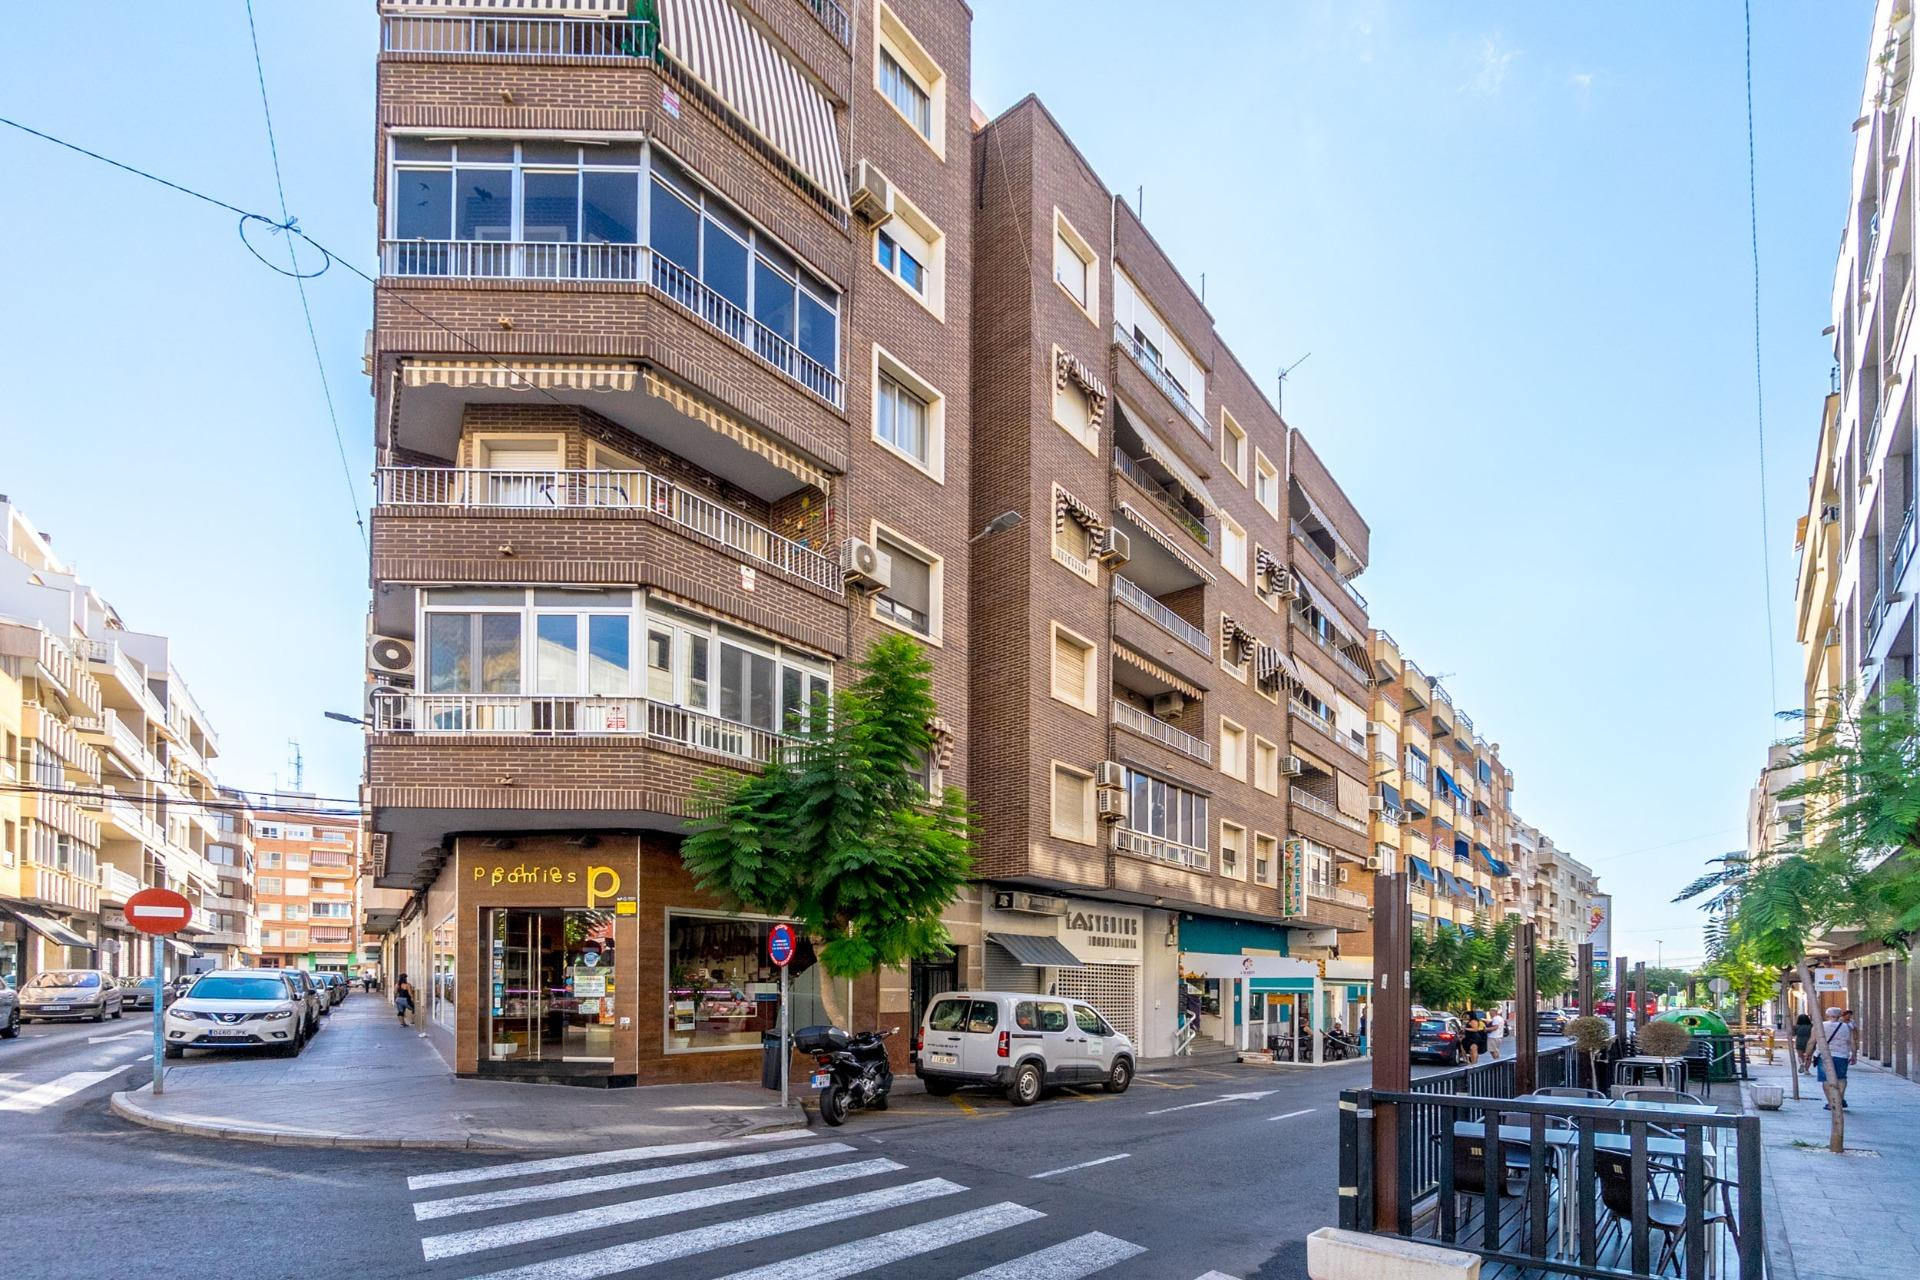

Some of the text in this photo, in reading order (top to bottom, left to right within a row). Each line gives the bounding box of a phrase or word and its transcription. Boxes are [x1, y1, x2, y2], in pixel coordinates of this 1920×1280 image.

[474, 863, 561, 881] pedro
[491, 870, 577, 887] pamies
[1066, 911, 1137, 936] EASYGOING
[1088, 936, 1137, 949] INMOBILIARIA
